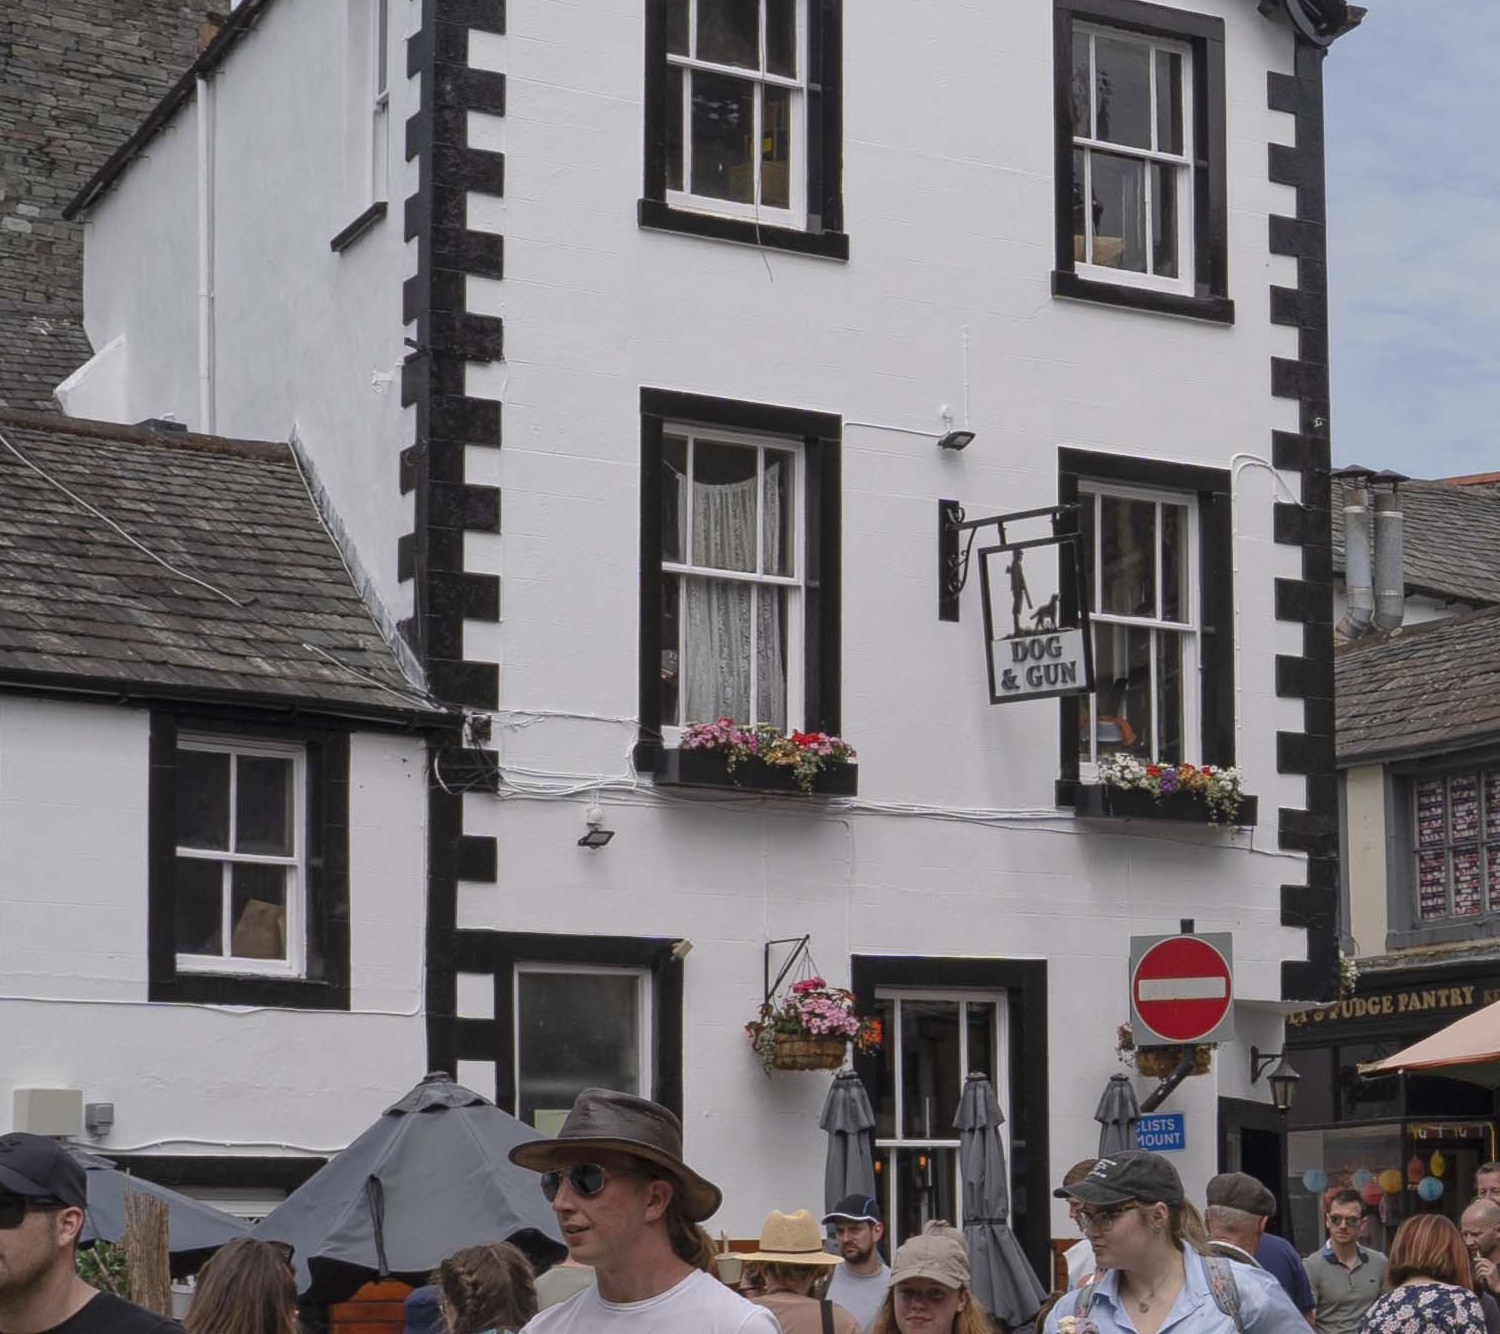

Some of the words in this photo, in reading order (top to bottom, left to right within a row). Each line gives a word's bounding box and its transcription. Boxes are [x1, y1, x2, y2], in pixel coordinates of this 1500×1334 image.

[1011, 635, 1062, 662] DOG
[1001, 668, 1020, 692] &
[1026, 661, 1077, 687] GUN
[1330, 995, 1394, 1021] FUDGE
[1398, 986, 1475, 1012] PANTRY
[1135, 1119, 1175, 1133] CLISTS
[1137, 1132, 1180, 1146] MOUNT
